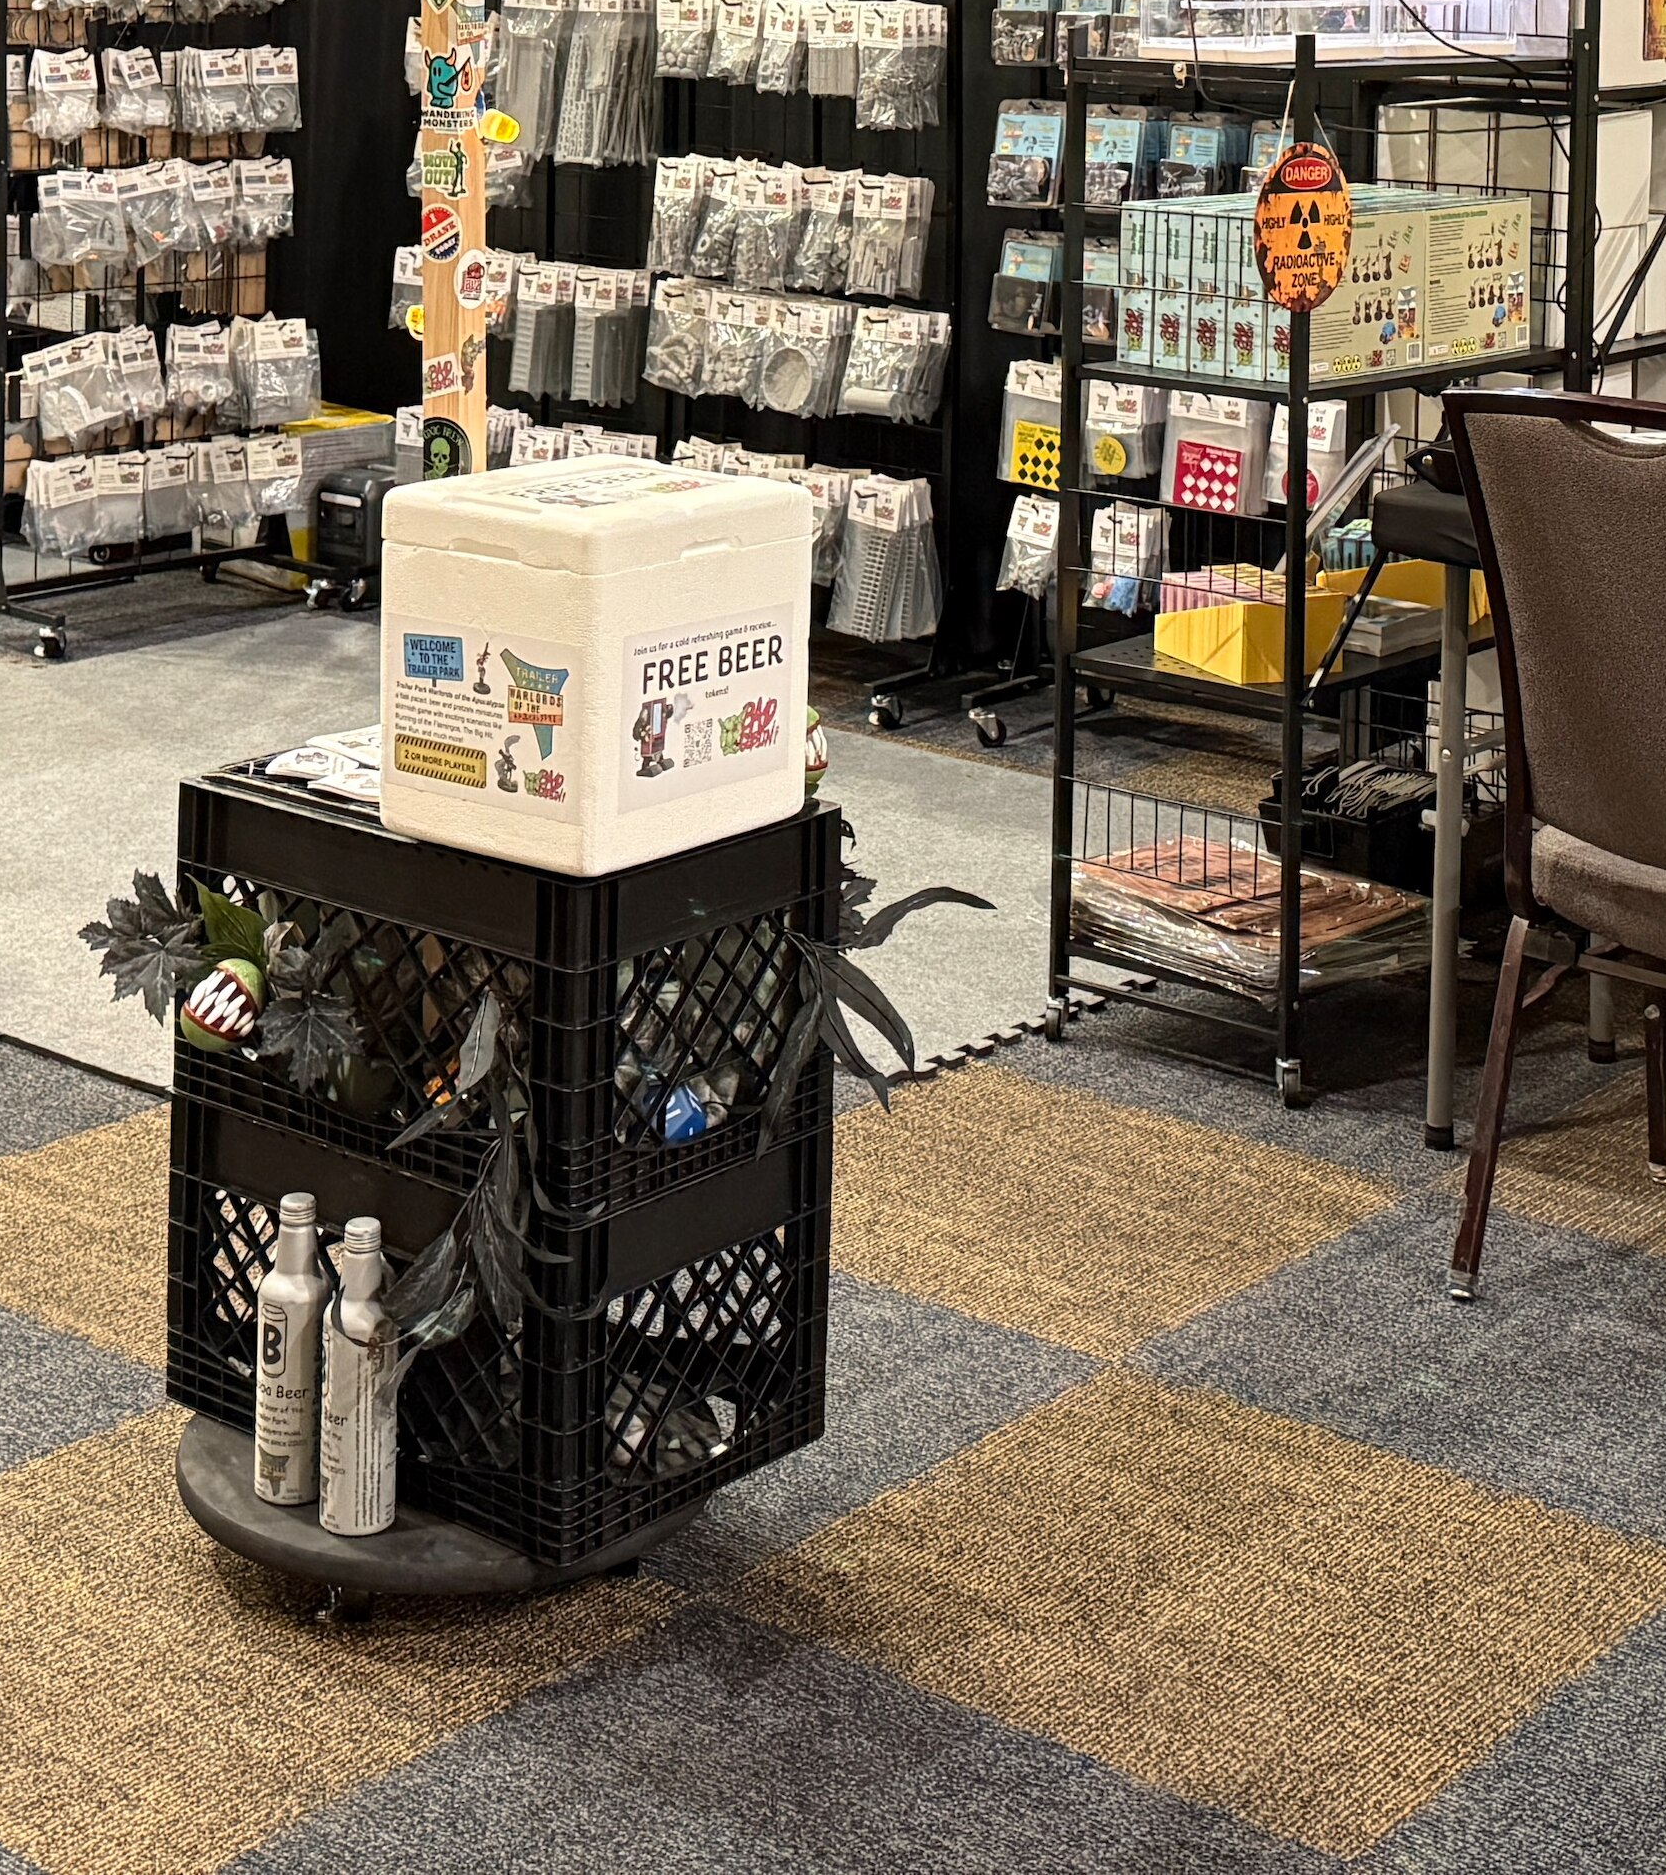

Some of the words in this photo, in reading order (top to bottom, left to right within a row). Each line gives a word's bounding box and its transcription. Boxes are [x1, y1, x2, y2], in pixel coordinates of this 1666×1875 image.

[421, 109, 475, 119] WANDERING
[423, 118, 474, 128] MONSTERS
[423, 153, 456, 168] MOVE
[1285, 165, 1329, 183] DANGER
[1262, 216, 1287, 230] HIGHLY
[1323, 213, 1346, 227] HIGHLY
[423, 220, 457, 247] DRANK
[435, 237, 456, 255] TODAY
[1273, 251, 1336, 271] RADIOACTIVE
[1291, 272, 1319, 288] ZONE
[409, 638, 457, 653] WELCOME
[419, 652, 432, 663] TO
[432, 653, 449, 665] THE
[642, 650, 709, 695] FREE
[718, 634, 784, 677] BEER
[408, 663, 439, 677] TRAILER
[439, 665, 460, 678] PARK
[515, 667, 558, 684] TRAILER
[414, 684, 427, 694] Park
[461, 694, 471, 702] the
[509, 687, 563, 709] WARLORDS
[705, 685, 729, 699] tokens!
[514, 701, 524, 711] OF
[526, 702, 541, 714] THE
[410, 751, 422, 762] OR
[422, 753, 444, 767] MORE
[444, 758, 477, 774] PLAYERS
[262, 1324, 281, 1364] B
[276, 1385, 310, 1399] Beer
